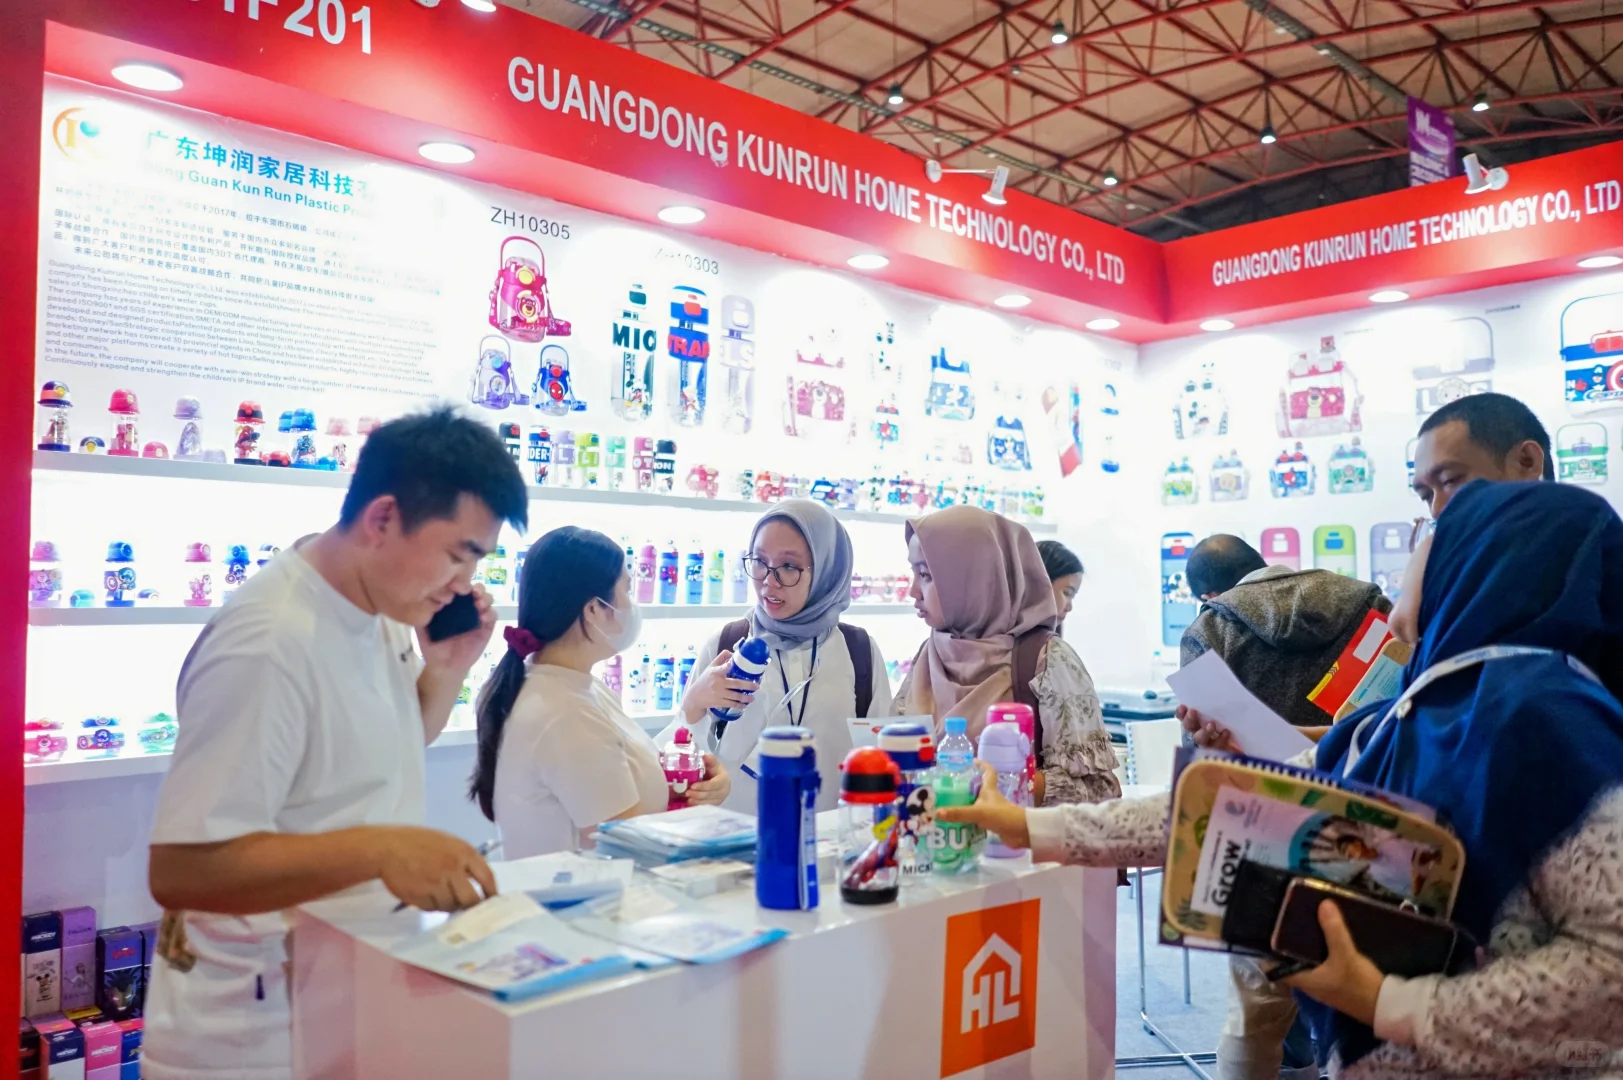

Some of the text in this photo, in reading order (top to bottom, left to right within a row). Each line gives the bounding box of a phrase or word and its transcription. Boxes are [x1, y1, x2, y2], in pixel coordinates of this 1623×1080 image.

[187, 168, 228, 189] Guan
[231, 177, 260, 196] Kun
[264, 185, 291, 203] Run
[295, 192, 339, 213] Plastic
[507, 56, 729, 162] GUANGDONG
[737, 130, 848, 200] KUNRUN
[855, 169, 921, 223] HOME
[925, 192, 1057, 263] TECHNOLOGY
[1096, 250, 1125, 285] LTD
[490, 206, 571, 240] ZH10305
[1212, 245, 1301, 287] GUANGDONG
[1304, 231, 1367, 269] KUNRUN
[1370, 219, 1417, 255] HOME
[1420, 194, 1538, 246] TECHNOLOGY
[1585, 179, 1621, 215] LTD
